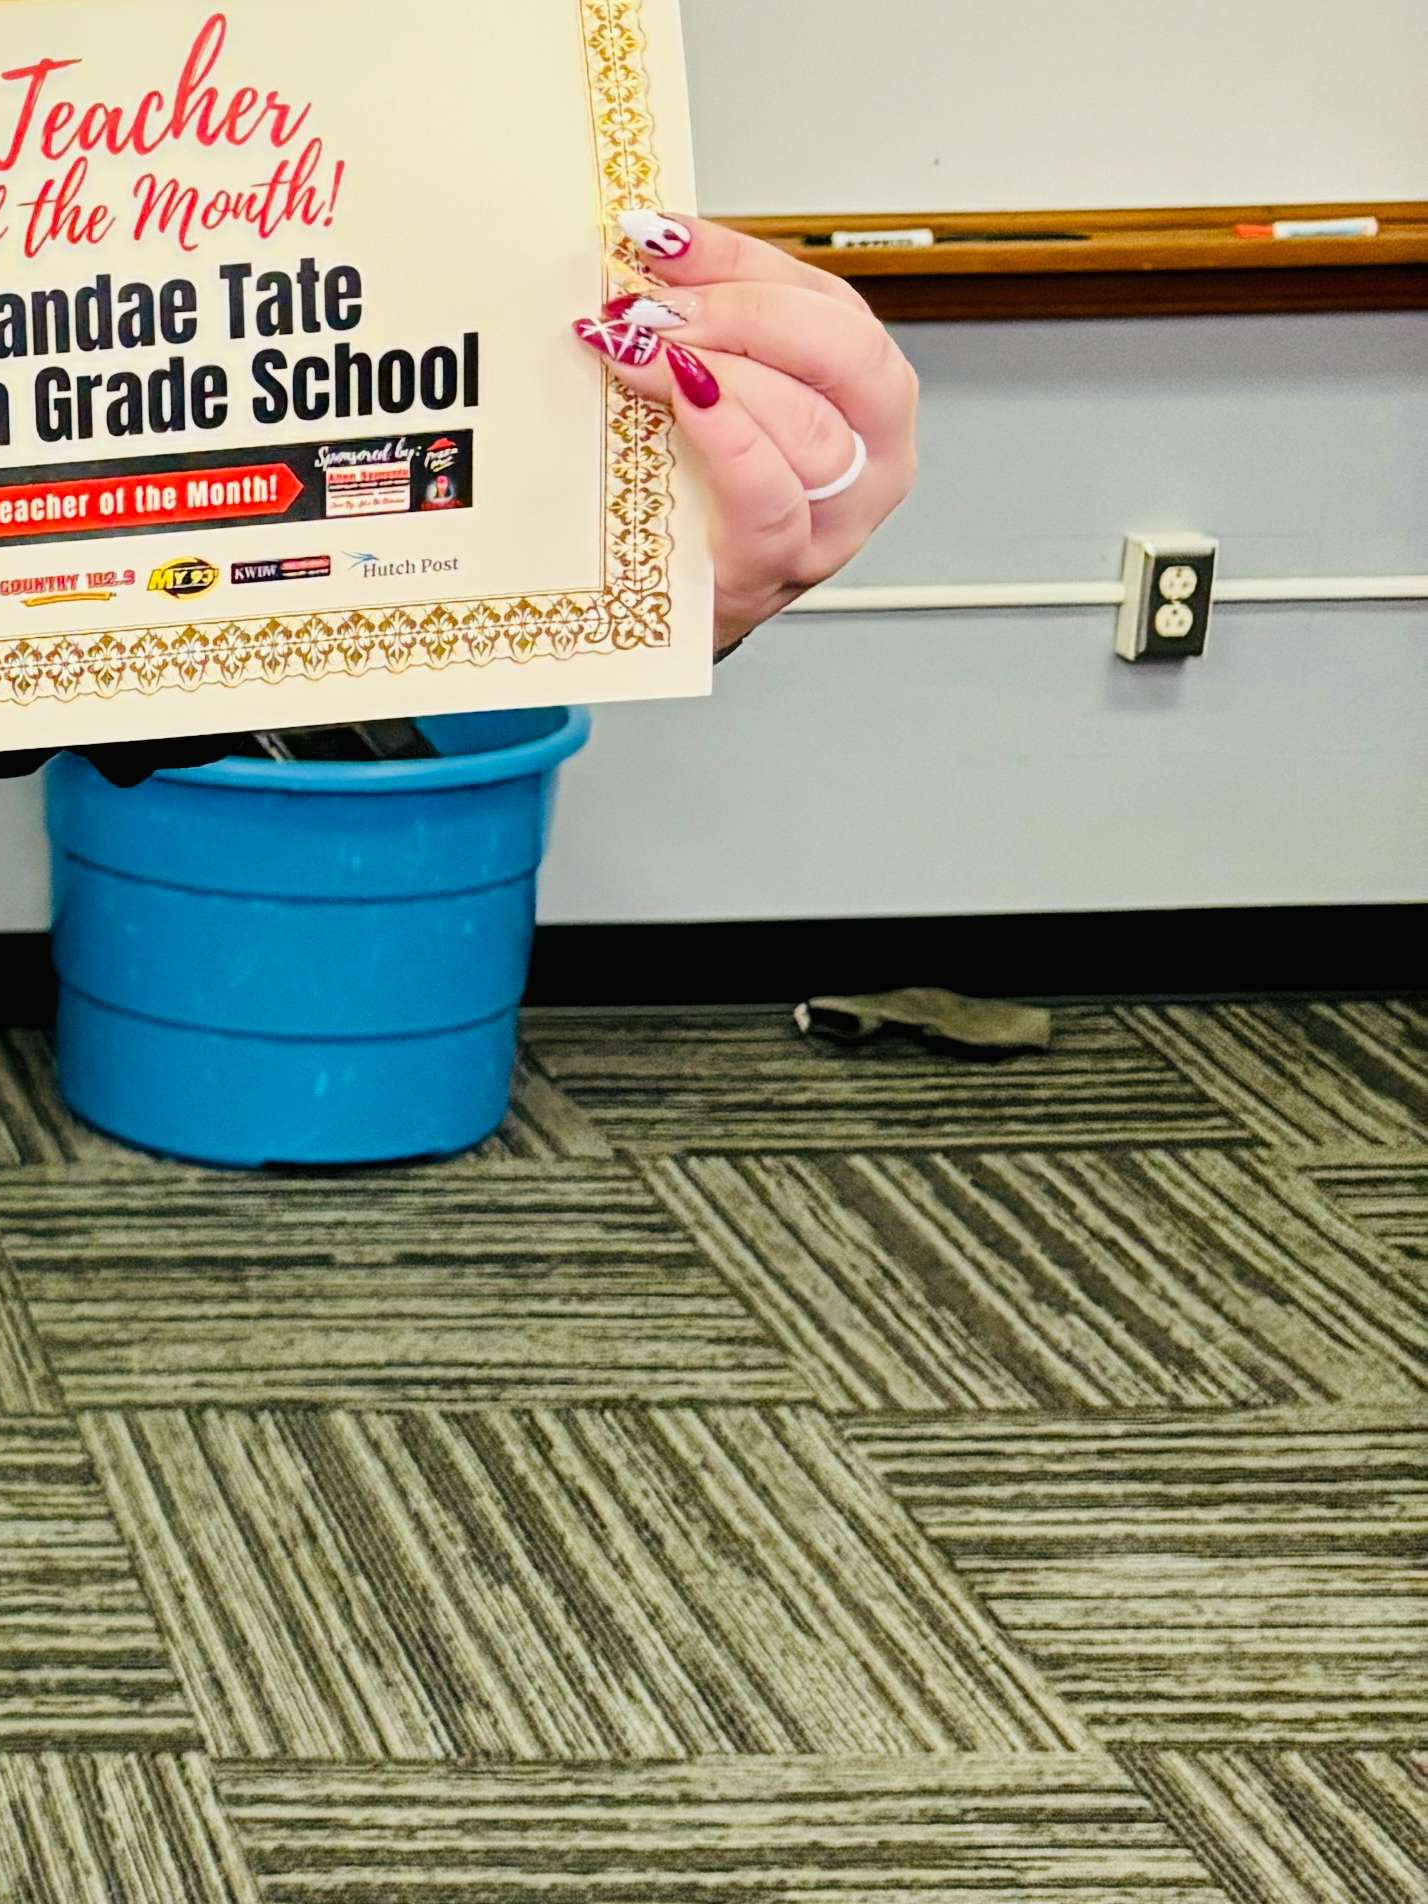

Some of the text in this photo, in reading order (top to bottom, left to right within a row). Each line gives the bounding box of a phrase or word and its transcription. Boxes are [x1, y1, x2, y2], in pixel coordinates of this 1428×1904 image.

[16, 155, 118, 260] the
[132, 137, 346, 252] Month!
[219, 256, 363, 342] Tate
[33, 356, 229, 445] Grade
[250, 331, 481, 426] School
[99, 487, 125, 515] of
[135, 483, 178, 510] the
[187, 476, 279, 509] Month!
[0, 573, 79, 597] COUNTRY
[363, 557, 459, 579] Hutch Post
